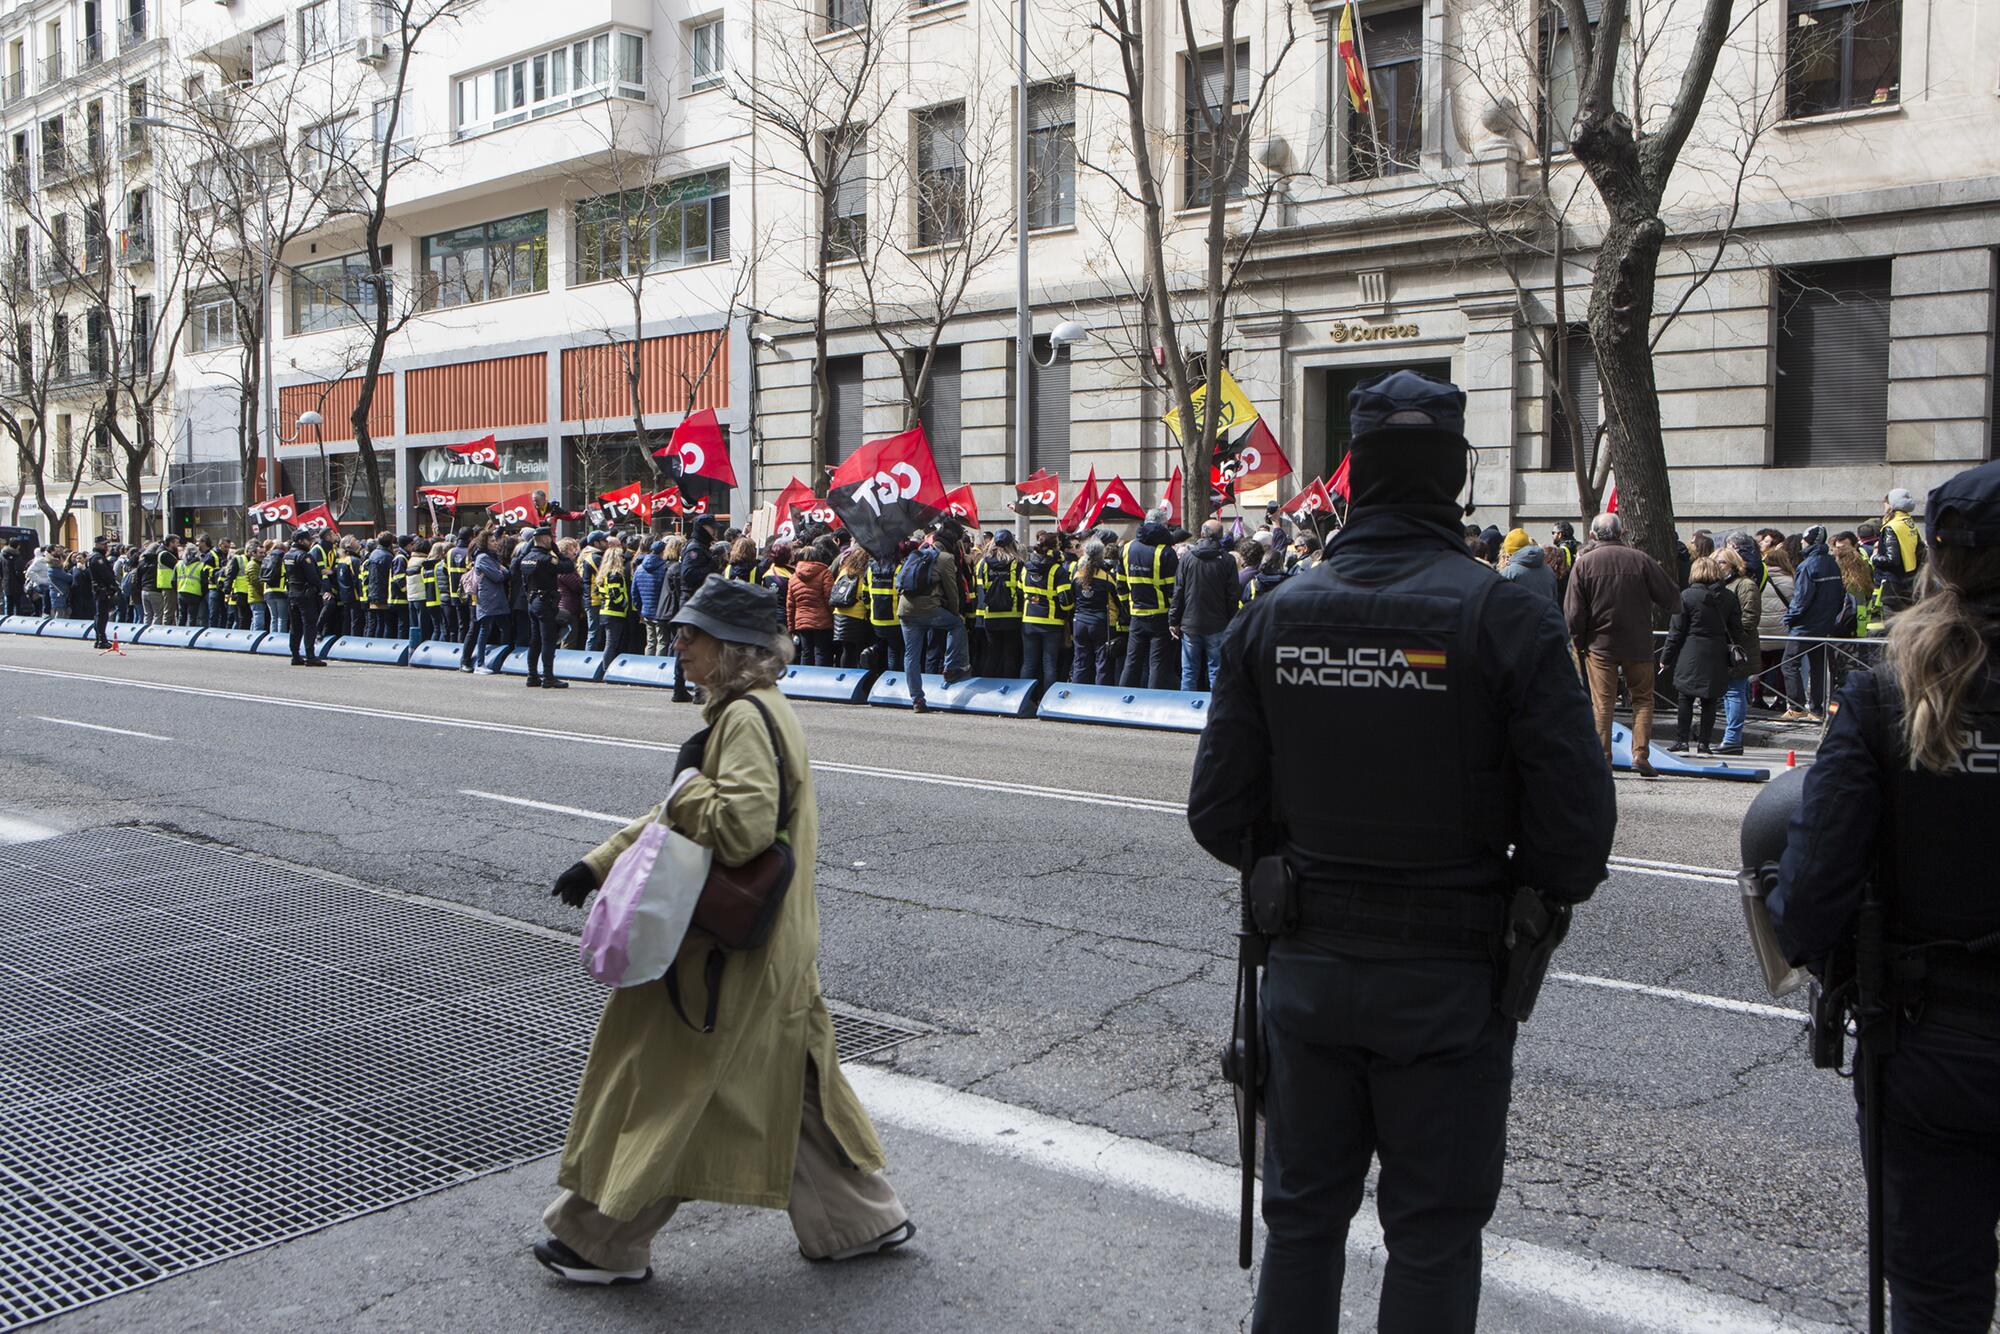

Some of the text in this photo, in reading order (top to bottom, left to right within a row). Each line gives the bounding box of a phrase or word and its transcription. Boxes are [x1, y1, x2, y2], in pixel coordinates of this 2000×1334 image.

[1350, 322, 1420, 342] Correos
[1275, 646, 1409, 667] POLICIA
[1275, 666, 1447, 690] NACIONAL
